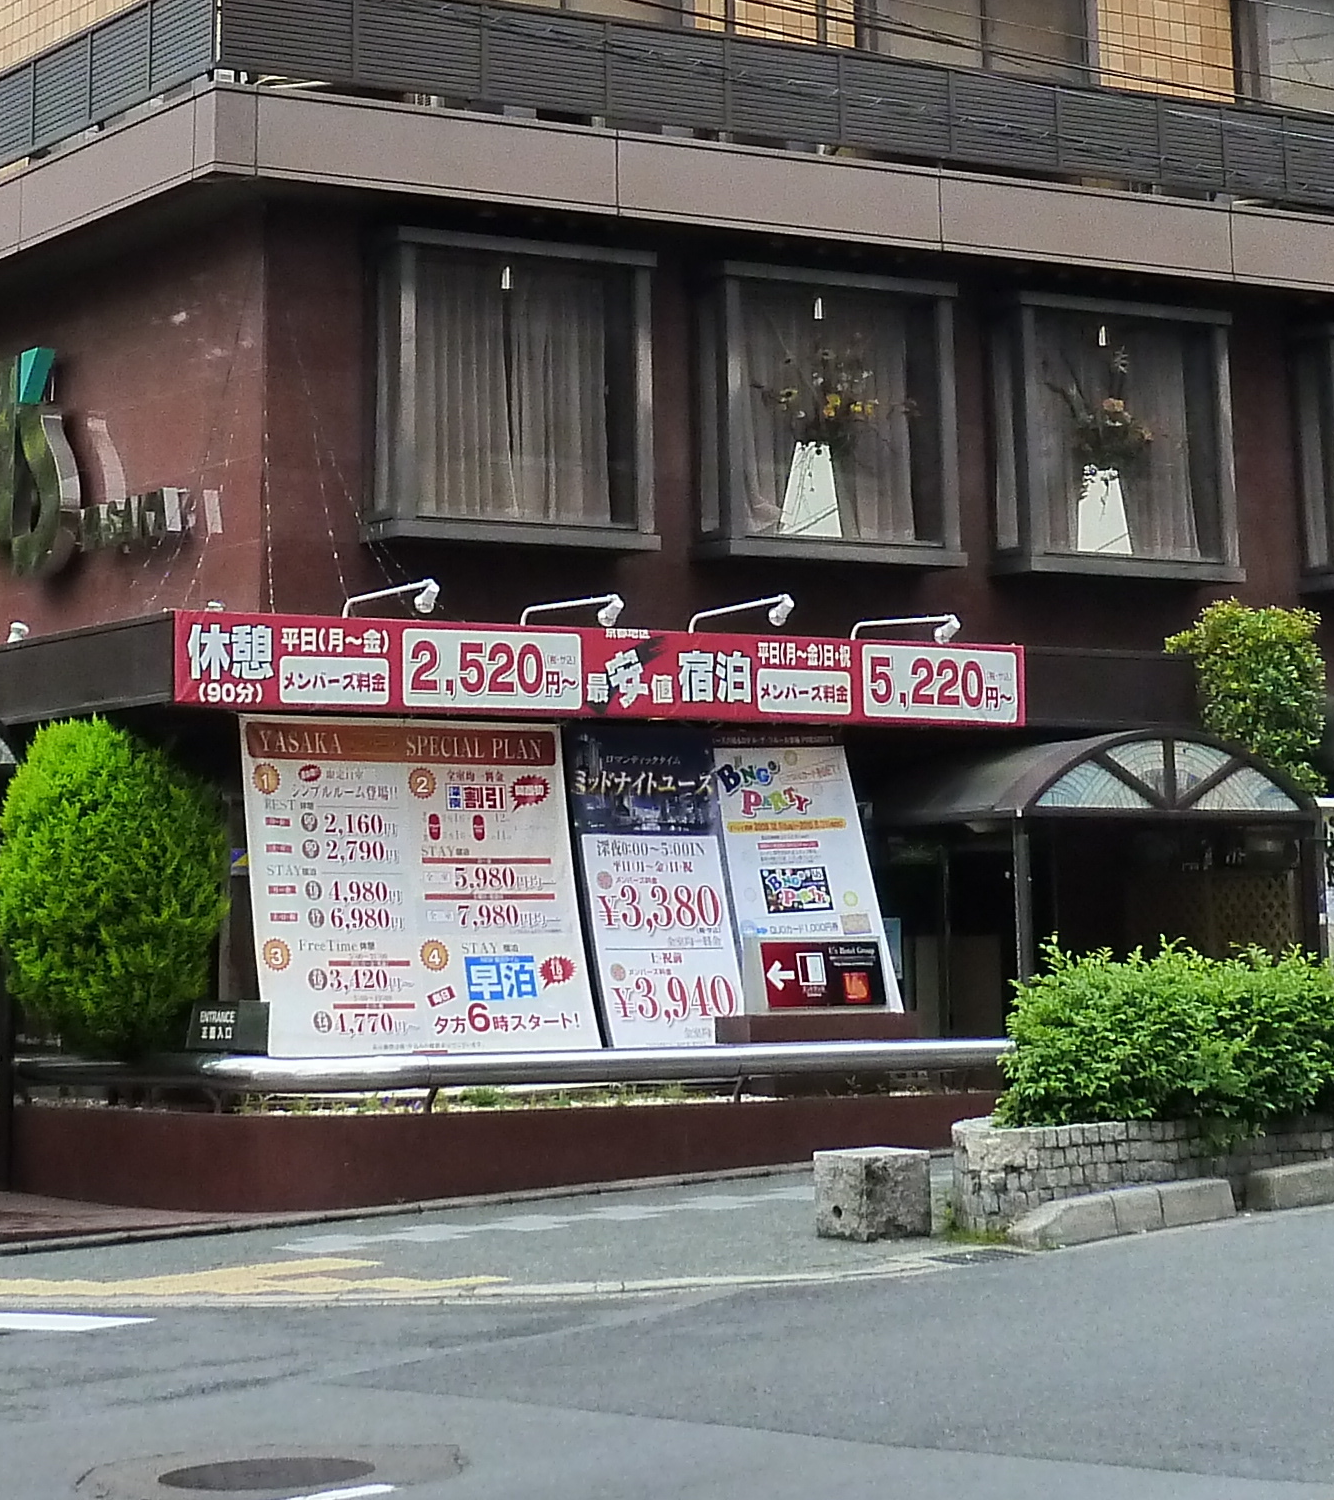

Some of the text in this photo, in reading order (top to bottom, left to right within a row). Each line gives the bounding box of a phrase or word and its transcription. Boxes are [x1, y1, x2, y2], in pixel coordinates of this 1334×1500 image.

[281, 627, 390, 654] 平日(月～金)
[187, 624, 274, 681] 休憩
[283, 669, 386, 694] メンバーズ料金
[586, 649, 753, 708] 最安値 宿泊
[198, 683, 263, 703] (90分)
[759, 682, 849, 705] メンバーズ料金
[259, 730, 543, 760] YASAKA SPECIAL PLAN
[606, 756, 681, 765] ロマンティックタイム
[261, 774, 268, 790] 1
[412, 777, 428, 793] 2
[574, 770, 714, 796] ミッドナイトユース
[265, 800, 296, 811] REST
[463, 786, 505, 809] 割引
[422, 845, 455, 857] STAY
[267, 864, 301, 876] STAY
[298, 939, 358, 951] FreeTime
[461, 942, 498, 954] STAY
[270, 947, 283, 965] 3
[428, 948, 441, 966] 4
[470, 963, 538, 1000] 早泊
[199, 1010, 237, 1023] ENTRANCE
[434, 1002, 581, 1035] 夕方6時スタート!
